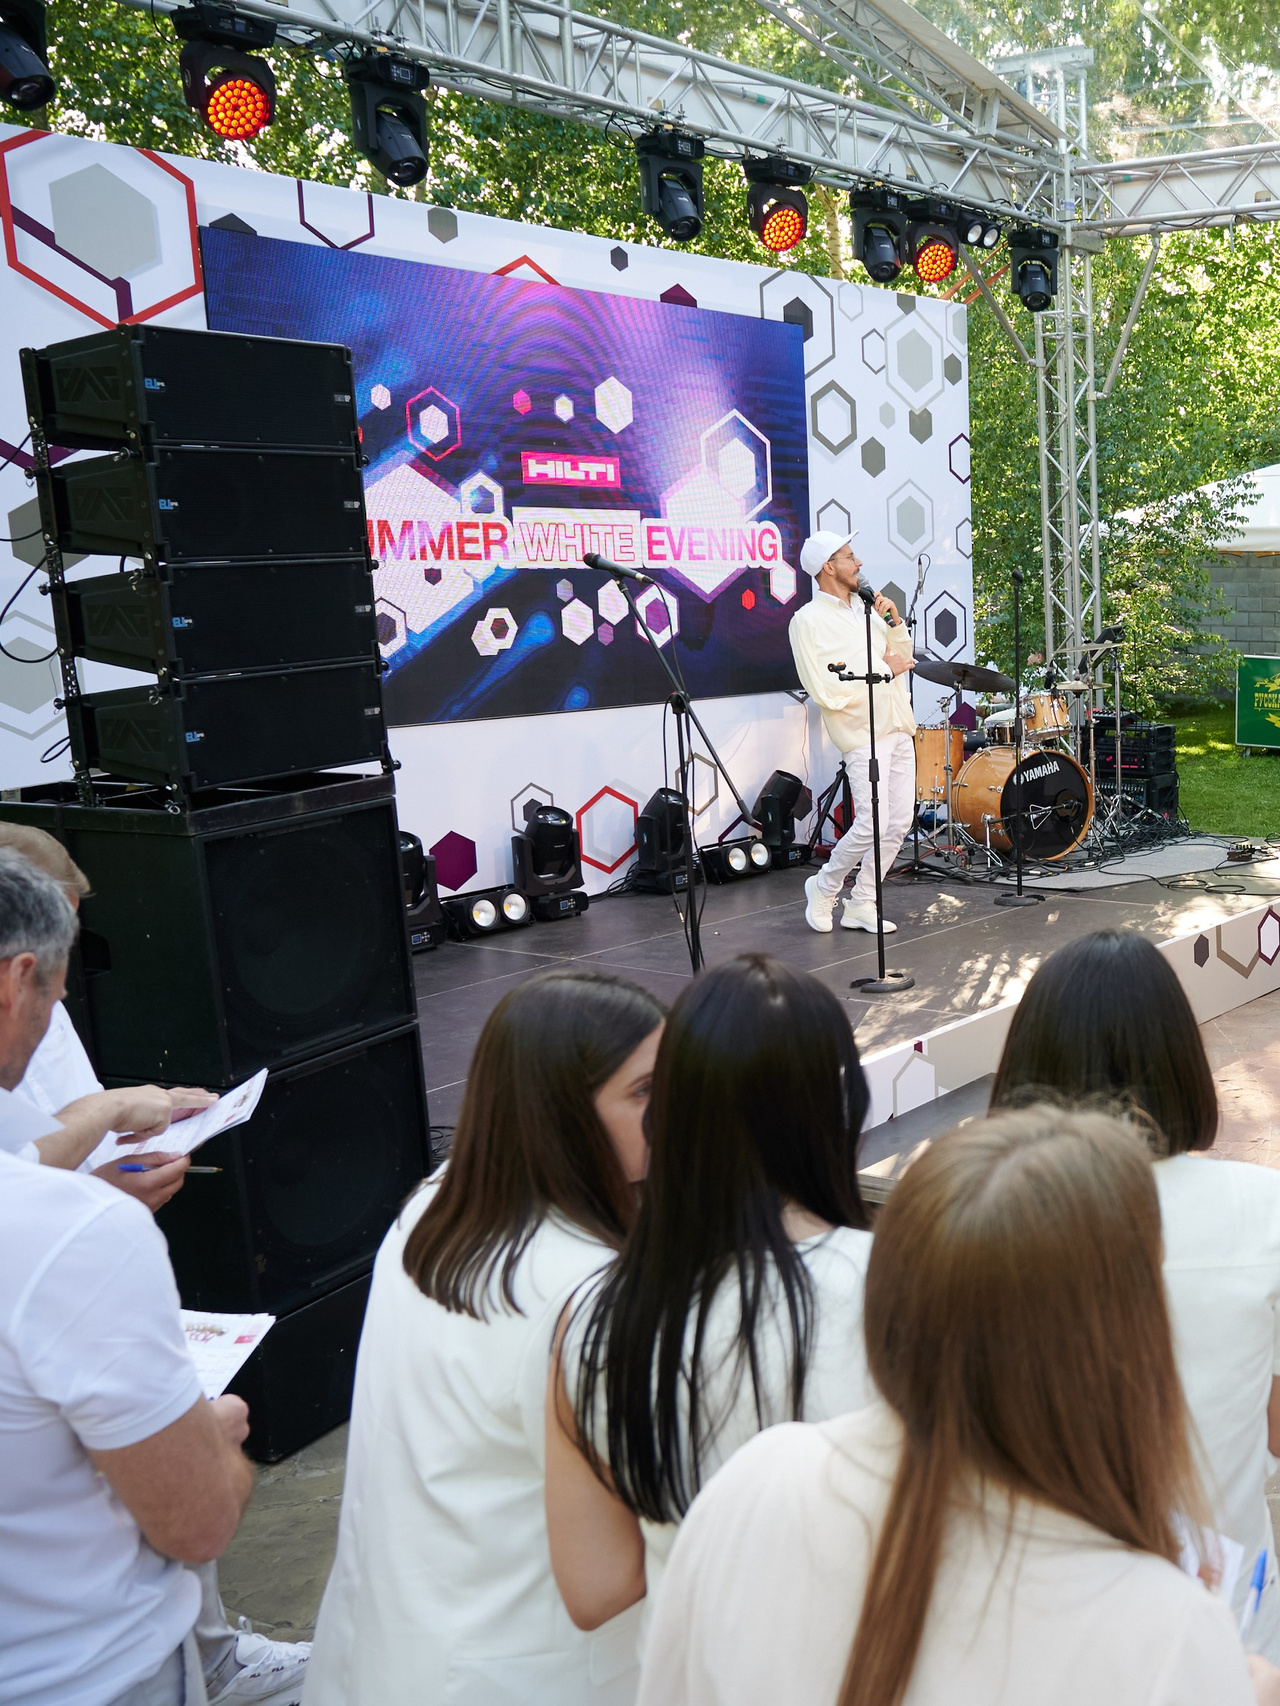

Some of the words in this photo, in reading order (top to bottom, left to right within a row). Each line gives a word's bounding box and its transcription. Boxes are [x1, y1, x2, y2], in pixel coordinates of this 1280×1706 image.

[528, 459, 615, 482] HILTI
[519, 522, 636, 562] WHITE
[646, 525, 778, 562] EVENING
[1023, 760, 1060, 782] YAMAHA
